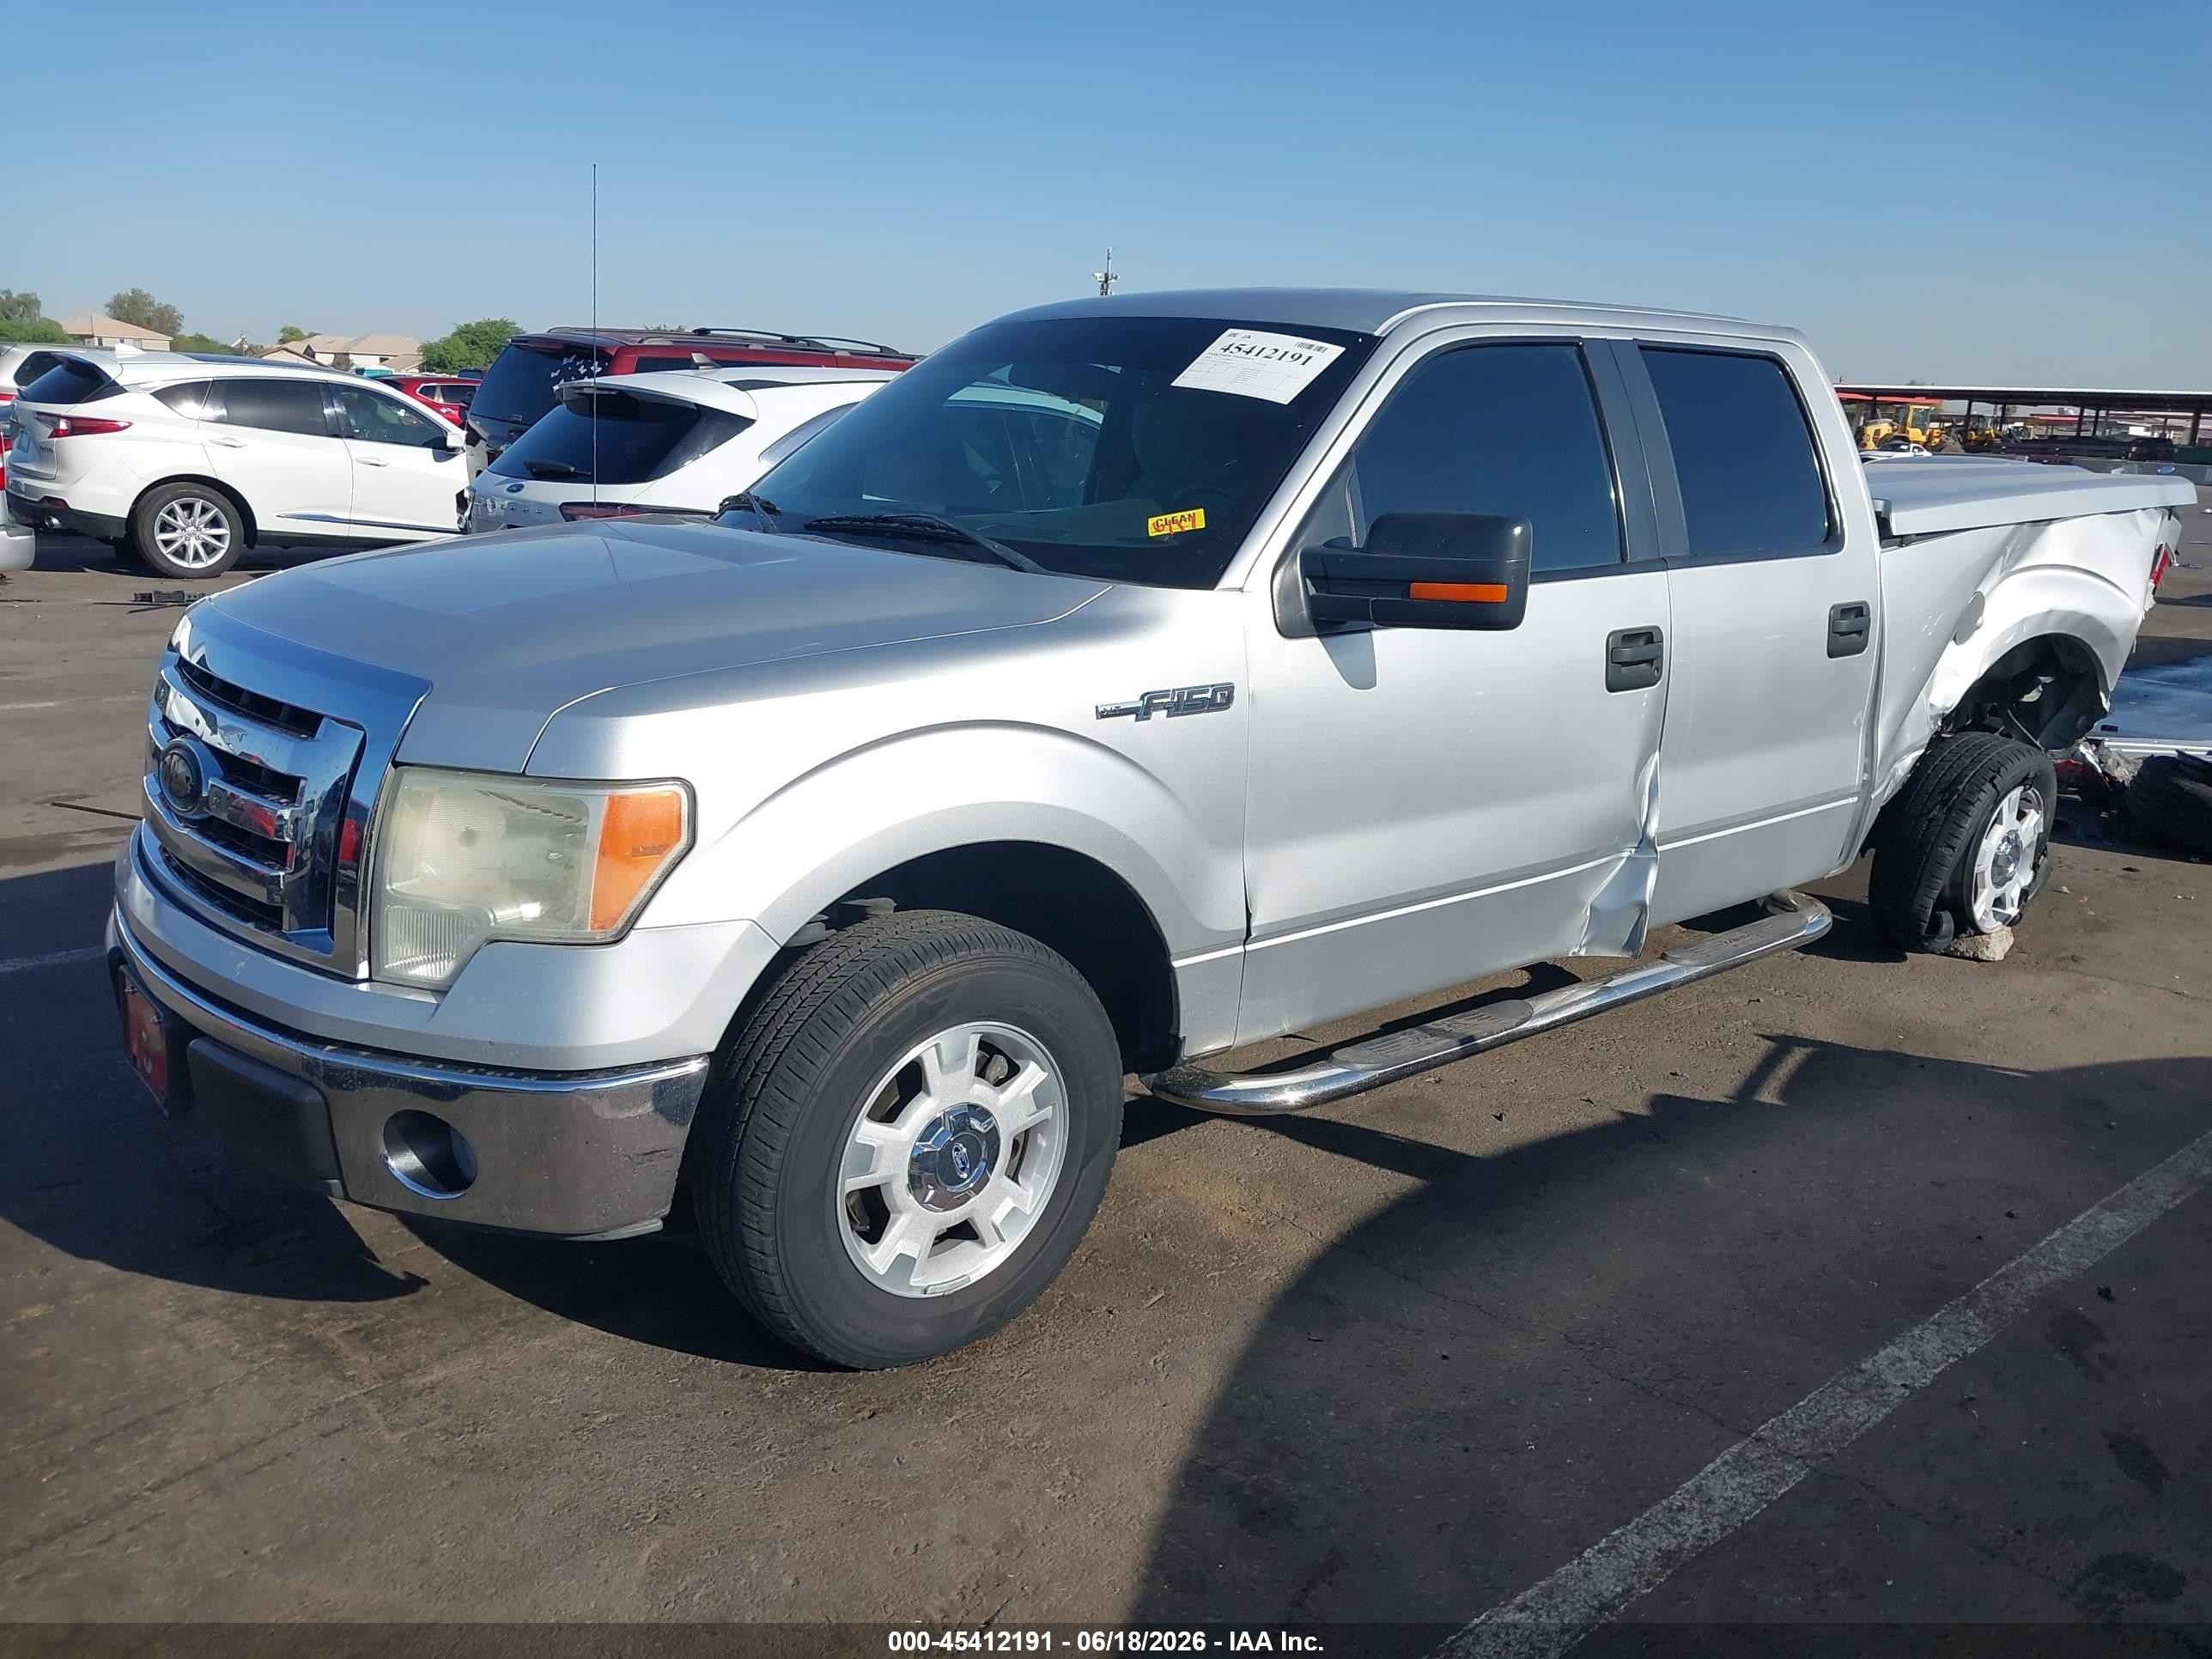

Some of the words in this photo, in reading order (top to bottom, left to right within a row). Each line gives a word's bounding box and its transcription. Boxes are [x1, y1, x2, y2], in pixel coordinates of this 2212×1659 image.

[1219, 342, 1314, 366] 45412191
[1155, 513, 1196, 527] CLEAN
[1135, 682, 1236, 722] F-150
